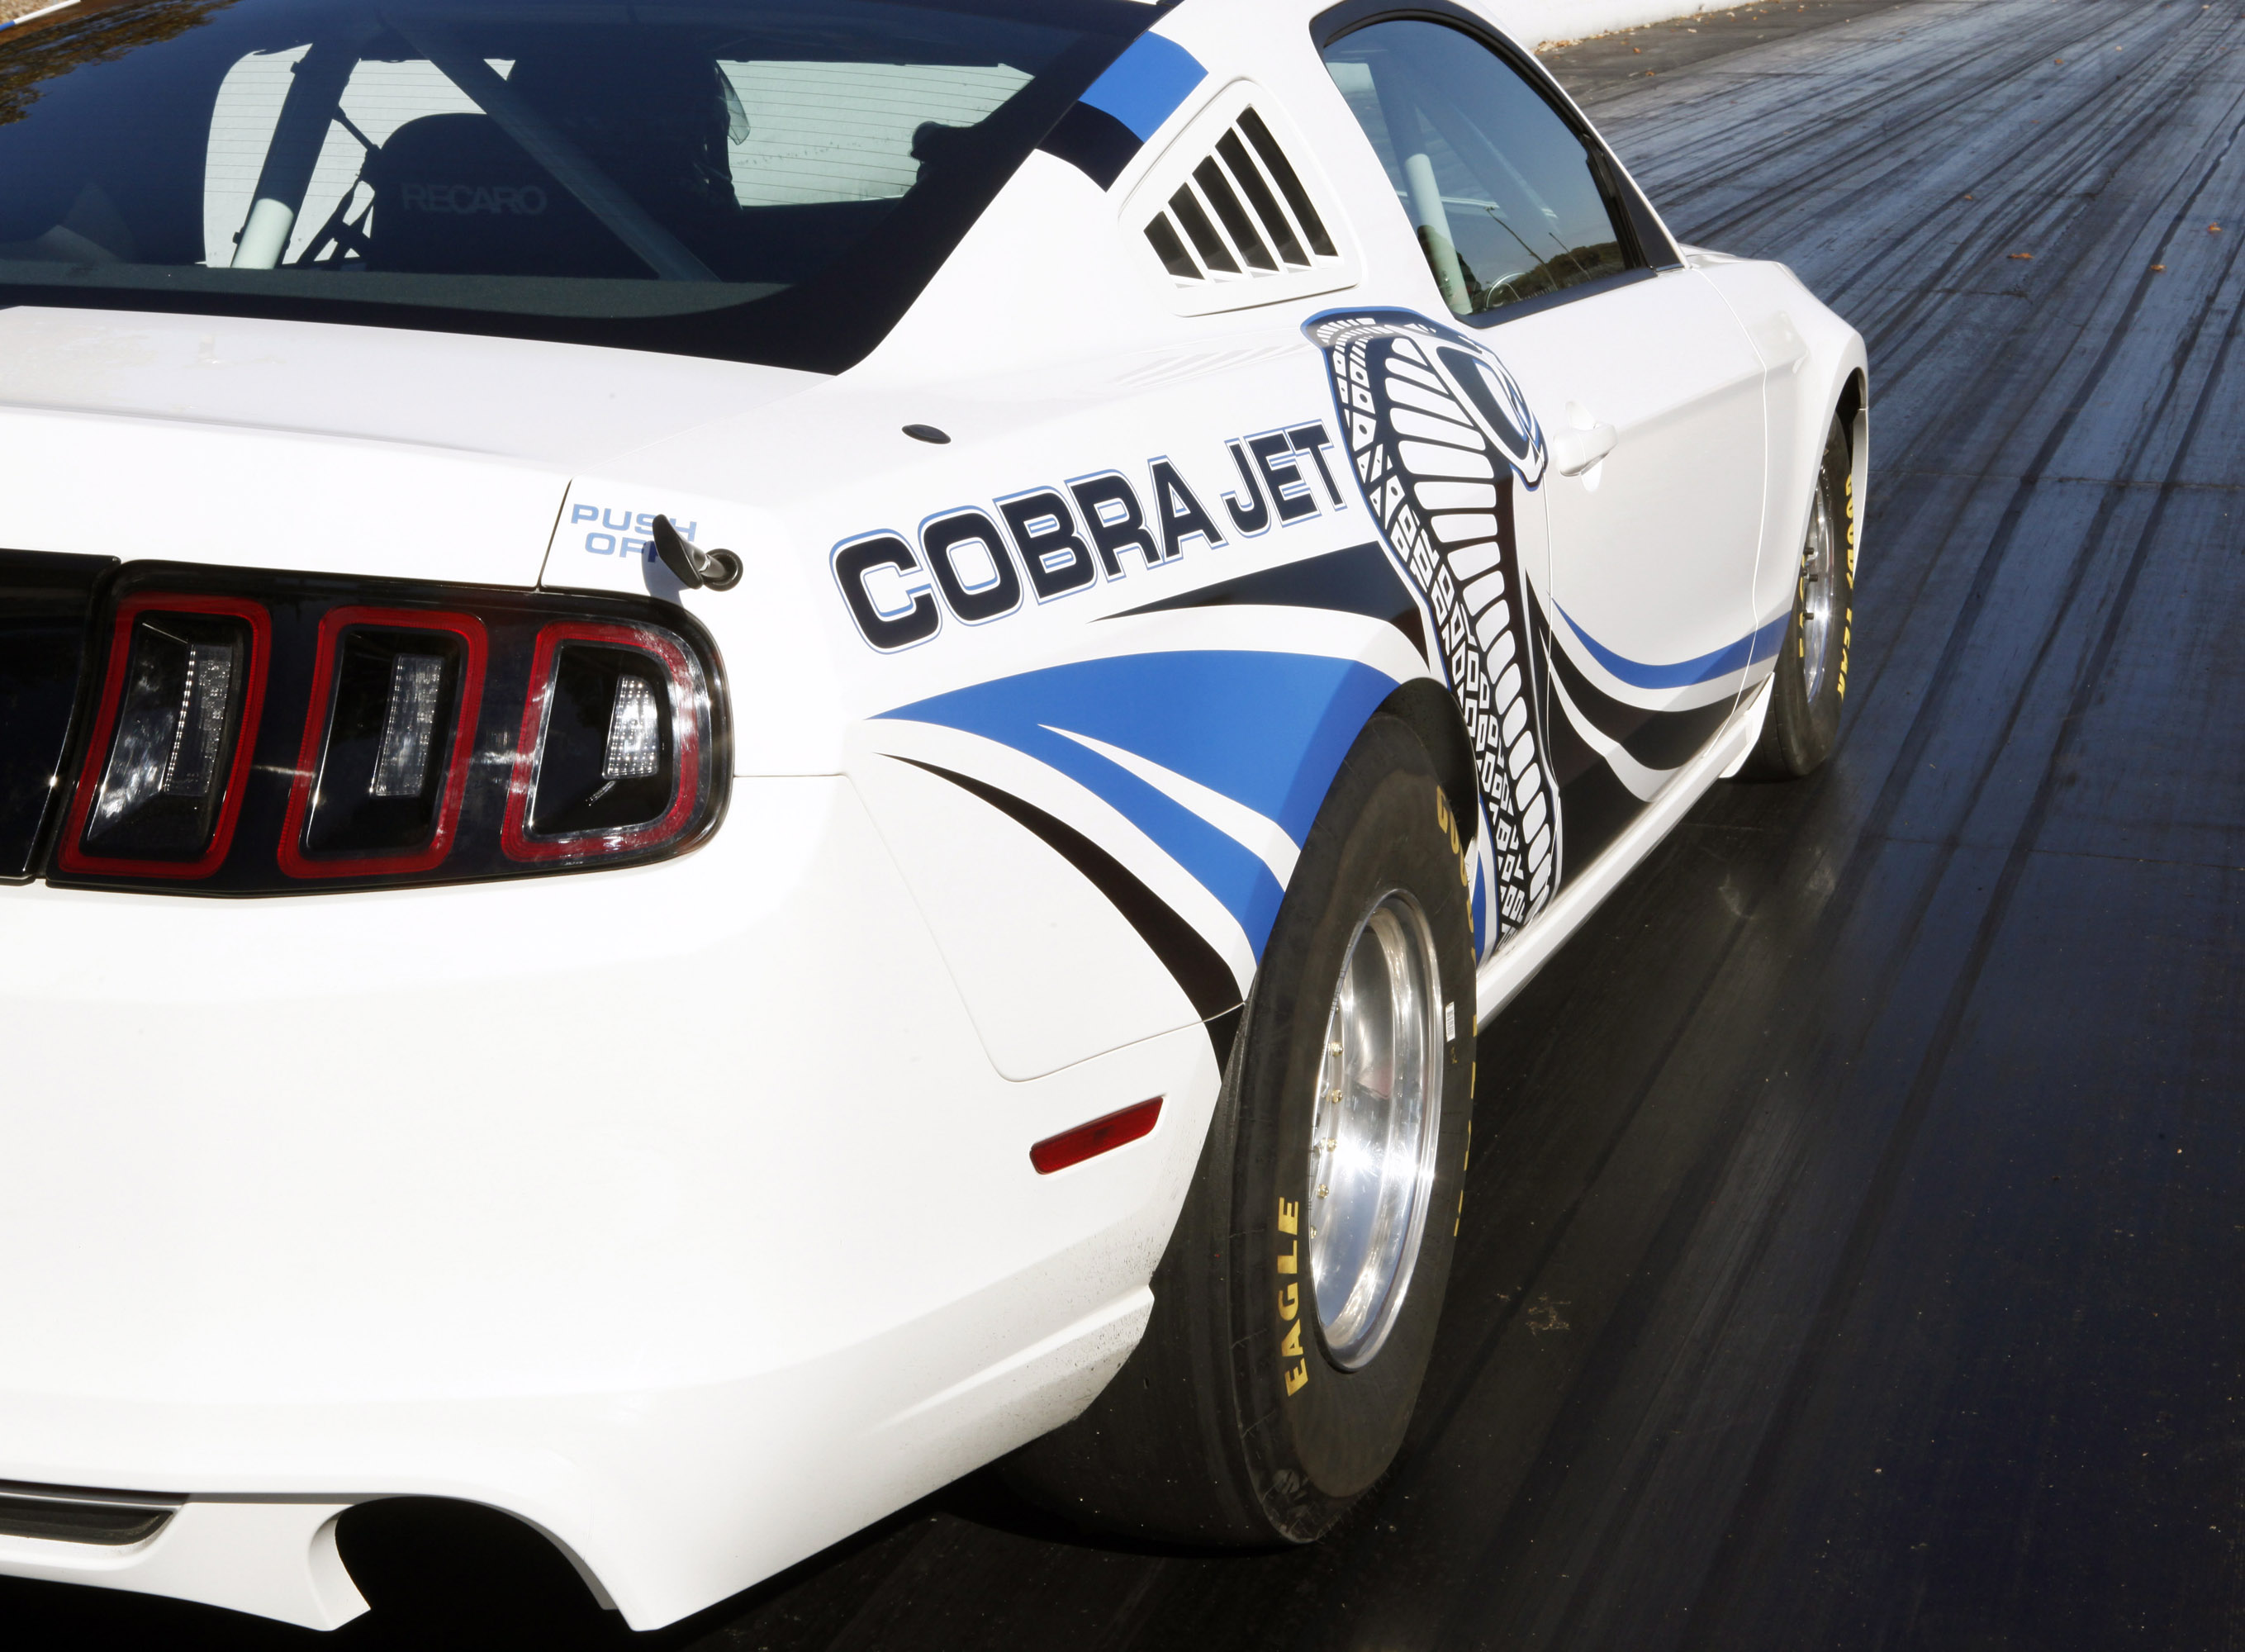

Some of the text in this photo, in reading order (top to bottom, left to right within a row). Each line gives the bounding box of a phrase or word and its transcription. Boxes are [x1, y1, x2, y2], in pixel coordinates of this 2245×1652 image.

[401, 183, 548, 216] RECARO
[571, 504, 697, 542] PUSH
[829, 418, 1348, 655] COBRA JET
[1278, 1197, 1308, 1397] EAGLE
